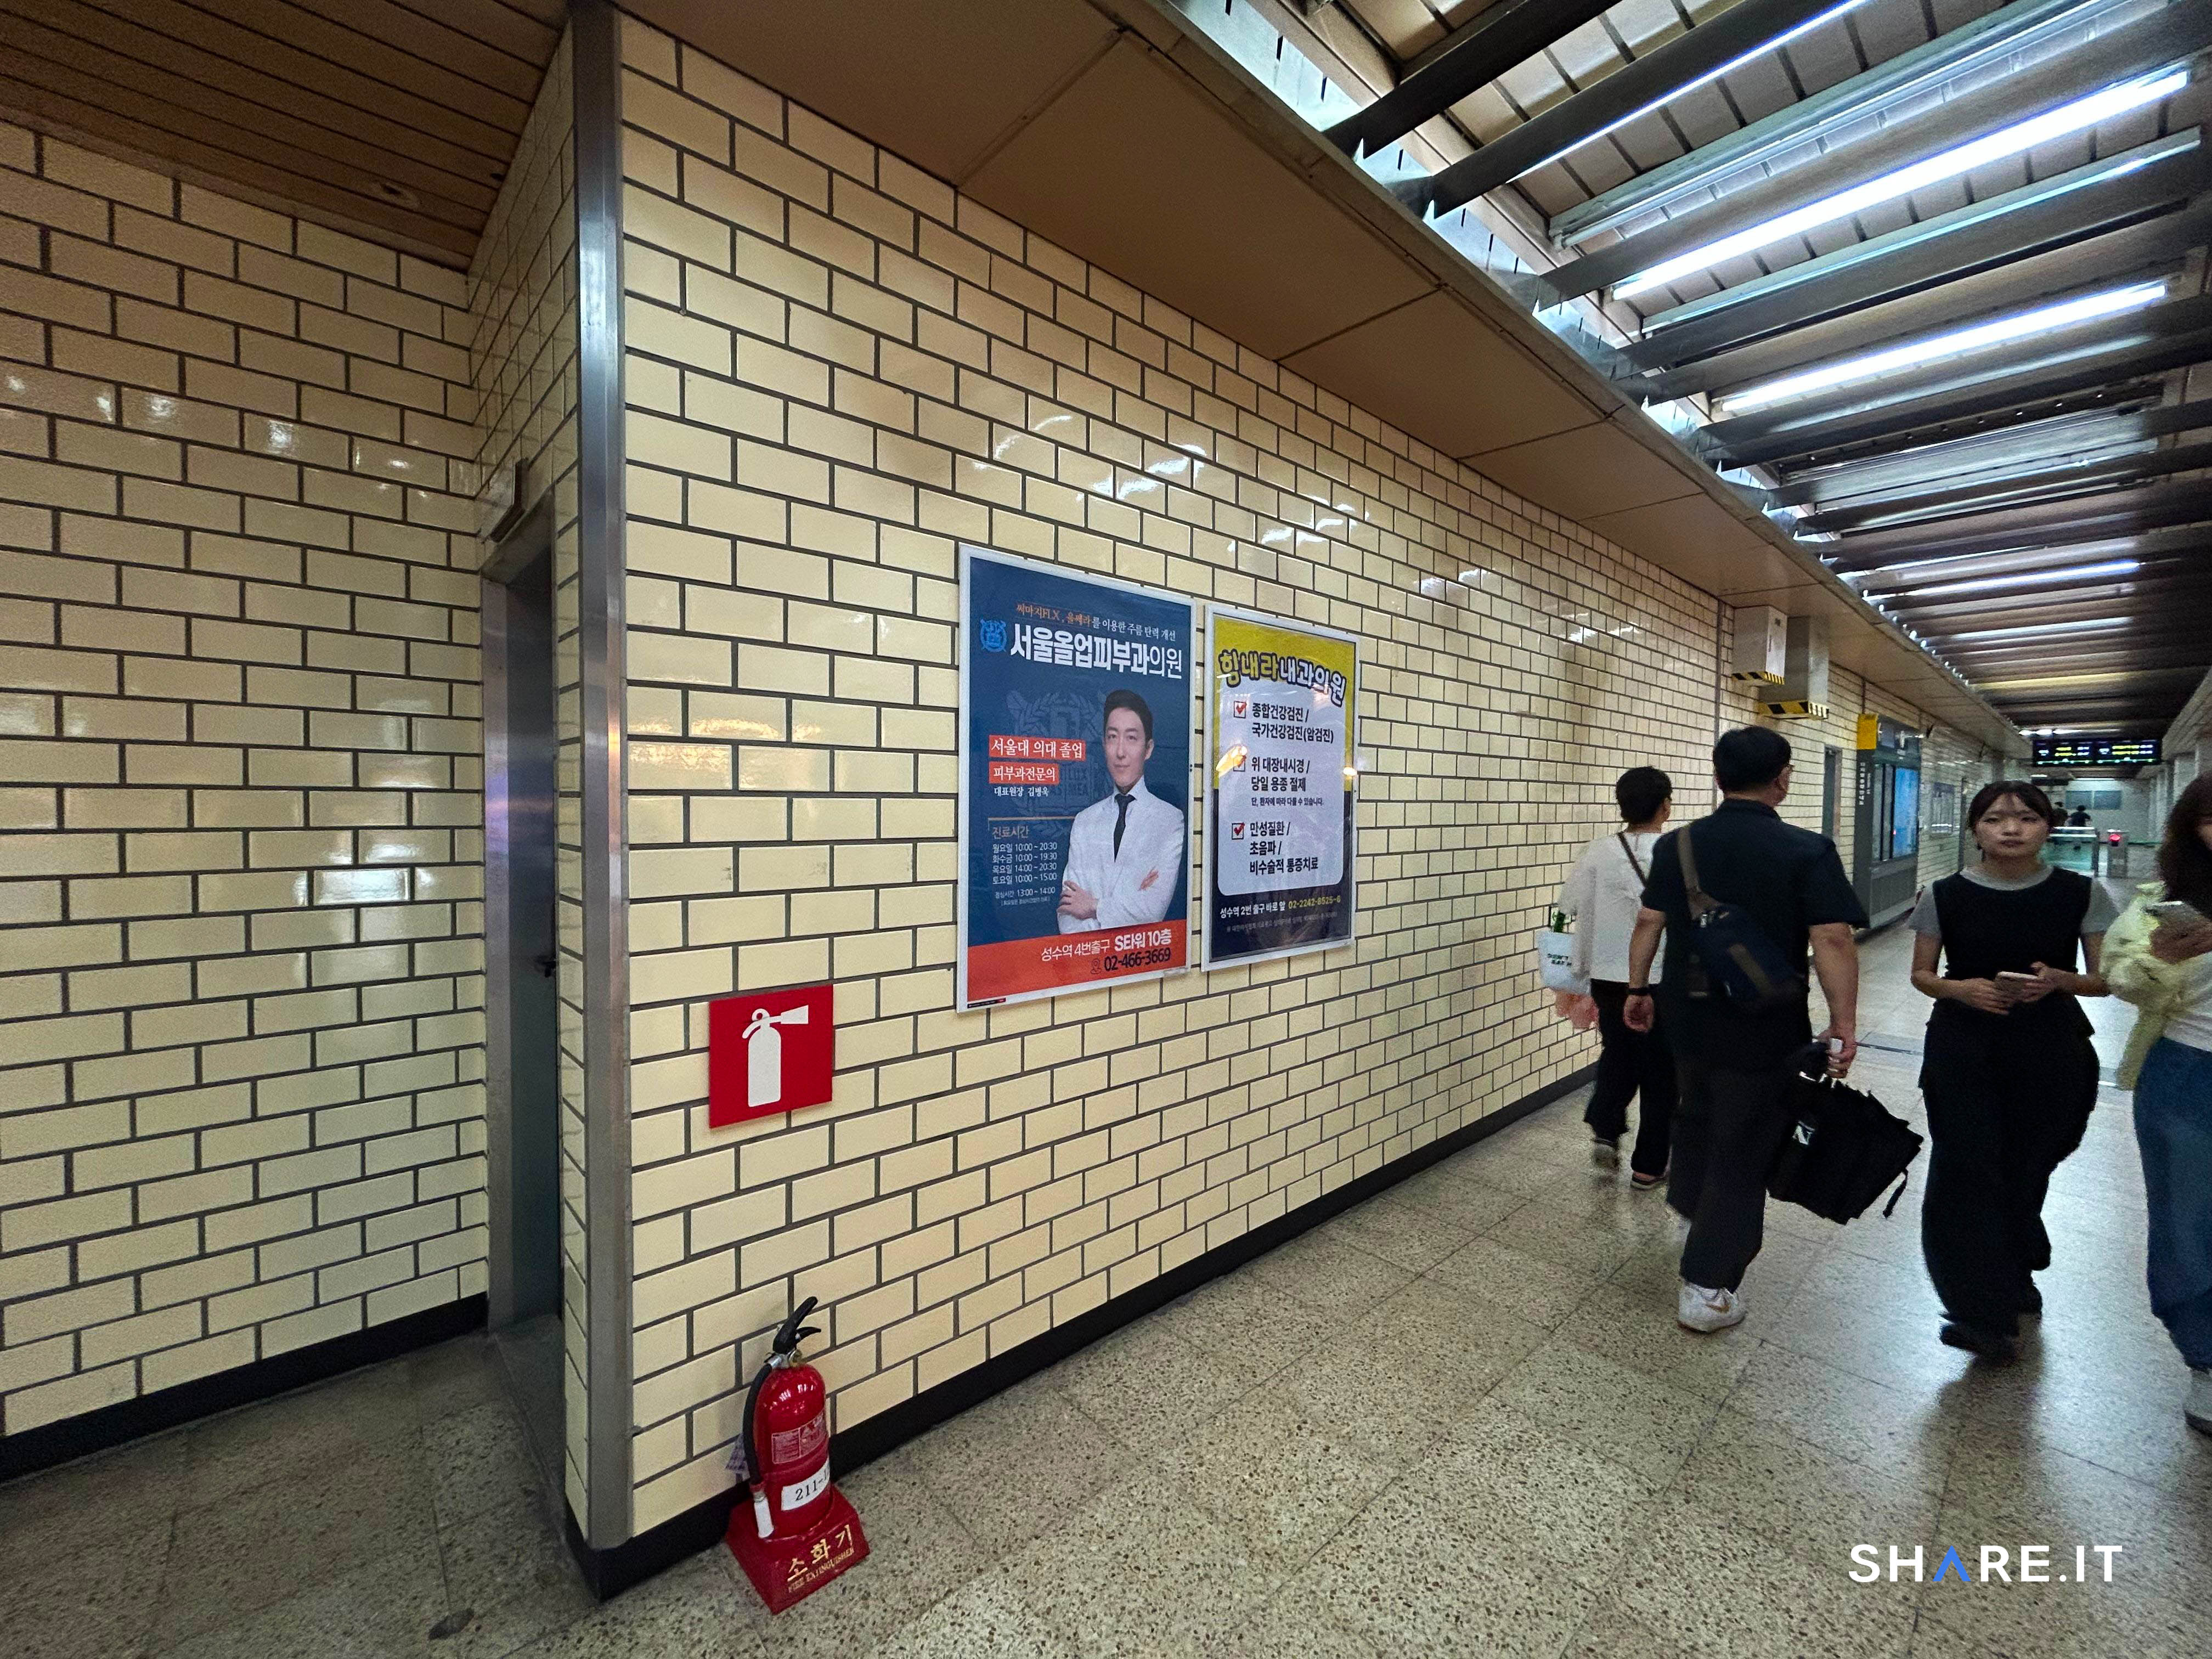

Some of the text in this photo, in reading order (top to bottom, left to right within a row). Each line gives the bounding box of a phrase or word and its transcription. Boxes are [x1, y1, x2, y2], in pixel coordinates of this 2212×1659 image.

[1102, 619, 1126, 633] 이용한
[1127, 623, 1143, 636] 주름
[1144, 626, 1159, 639] 탄력
[1161, 629, 1175, 641] 개선
[1010, 623, 1182, 679] 서울올업피부과의원
[1252, 702, 1310, 723] 종합건강검진 /
[1252, 722, 1334, 743] 국가건강검진(암검진)
[991, 738, 1082, 759] 서울대 의대 졸업
[994, 765, 1056, 782] 피부과전문의
[1251, 757, 1310, 774] 위 대장내시경 /
[994, 786, 1024, 797] 대표원장
[1251, 776, 1306, 792] 당일 용종 절제
[1276, 797, 1286, 806] 따라
[1287, 797, 1296, 806] 다를
[1298, 798, 1302, 806] 수
[992, 825, 1029, 839] 진료시간
[1250, 821, 1291, 837] 만성질환 /
[992, 843, 1012, 854] 월요일
[1015, 843, 1032, 851] 10:00
[1040, 842, 1057, 850] 20:30
[1250, 840, 1282, 856] 초음파 /
[992, 854, 1012, 864] 화수금
[1015, 854, 1032, 862] 10:00
[1040, 852, 1057, 860] 19:30
[992, 865, 1012, 874] 목요일
[1015, 864, 1032, 872] 14:00
[1039, 862, 1057, 871] 20:30
[1250, 857, 1318, 876] 비수술적 통증치료
[992, 875, 1012, 884] 토요일
[1015, 874, 1032, 883] 10:00
[1017, 889, 1033, 897] 13:00
[1040, 887, 1056, 895] 14:00
[1220, 906, 1239, 919] 성수역
[1240, 905, 1252, 916] 2번
[1041, 929, 1172, 961] 성수역 4번출구 S타워 10층
[1104, 947, 1171, 972] 02-466-3669
[787, 1525, 853, 1582] 소화기
